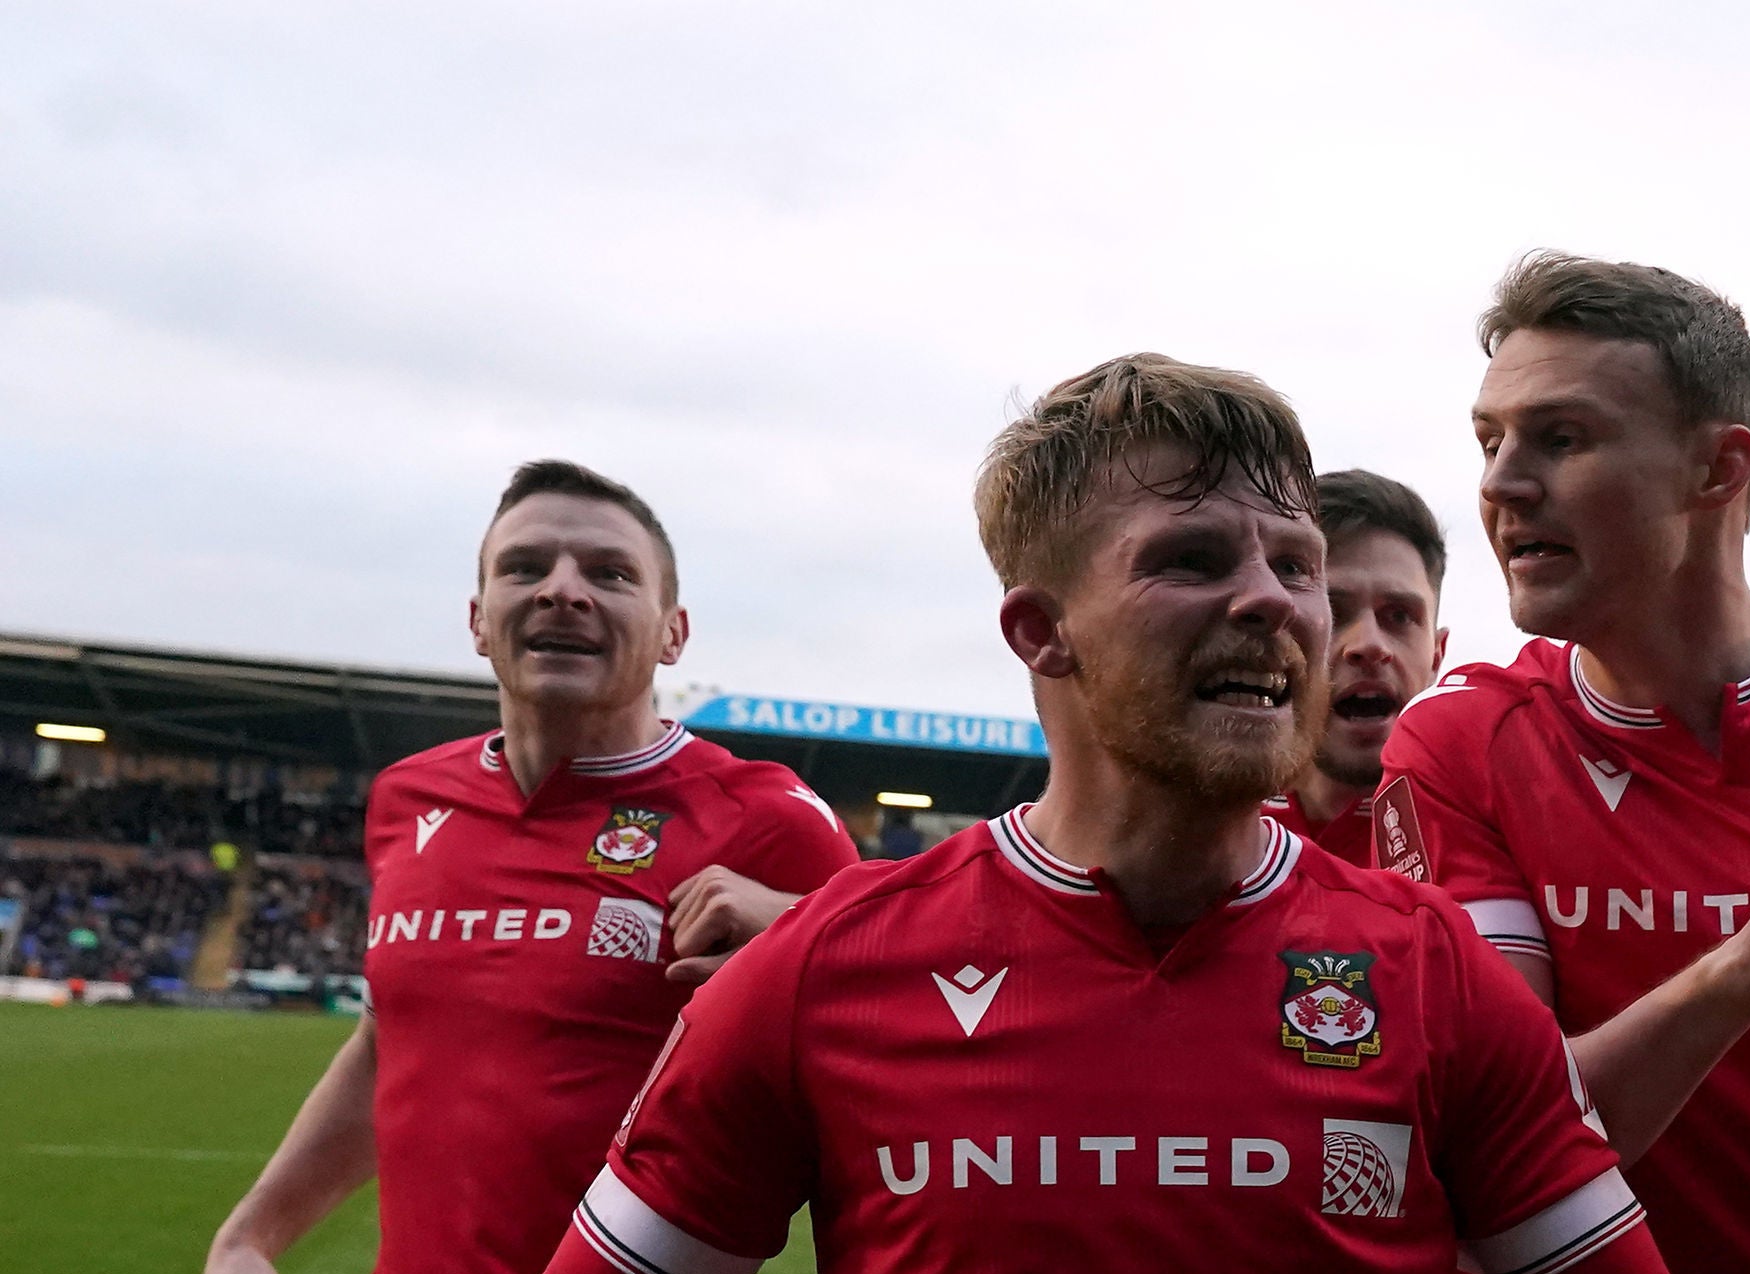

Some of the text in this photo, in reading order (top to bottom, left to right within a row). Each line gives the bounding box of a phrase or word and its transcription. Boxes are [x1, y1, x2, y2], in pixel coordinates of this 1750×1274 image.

[729, 699, 1032, 750] SALOP LEISURE
[367, 907, 573, 950] UNITED
[1544, 884, 1749, 935] UNIT
[876, 1135, 1291, 1196] UNITED
